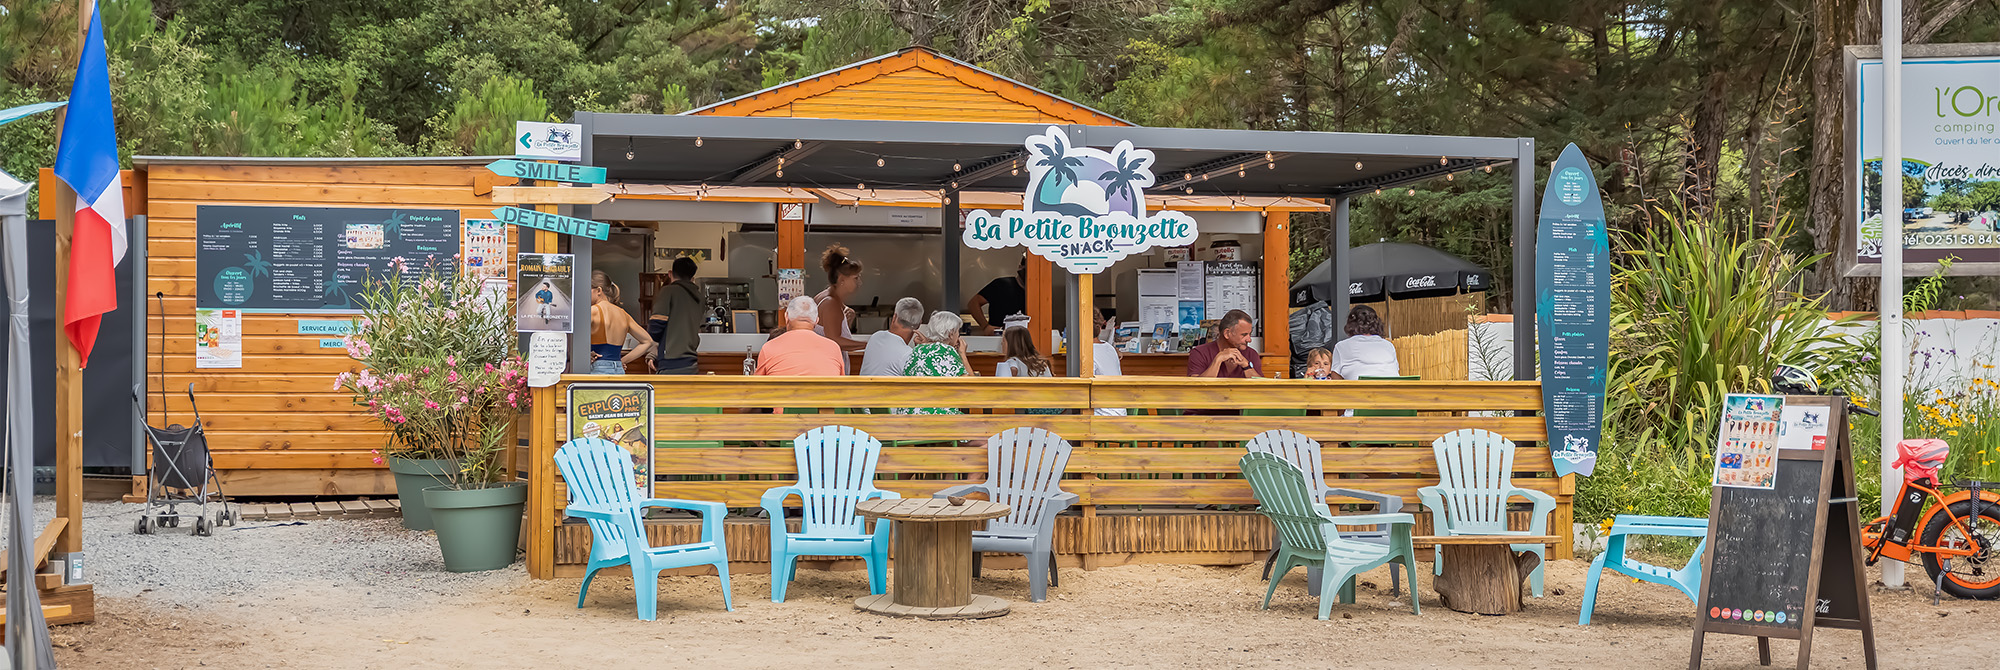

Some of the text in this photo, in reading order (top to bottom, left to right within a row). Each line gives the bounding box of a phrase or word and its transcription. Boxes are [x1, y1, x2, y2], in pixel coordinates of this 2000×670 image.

[1935, 85, 2000, 118] l'Or
[1934, 122, 1995, 134] camping
[1935, 137, 1964, 145] Ouvert
[1966, 137, 1978, 145] du
[514, 162, 580, 181] SMILE
[1927, 162, 1971, 180] Accès
[504, 207, 598, 238] DETENTE
[972, 216, 1190, 245] La Petite Bronzette
[1060, 238, 1114, 256] SNACK
[1904, 234, 1920, 244] tél.
[1924, 235, 1942, 245] 02
[1946, 235, 1957, 245] 51
[1960, 234, 1975, 244] 58
[1978, 234, 1992, 244] 84
[1406, 275, 1436, 289] Coca-Cola
[580, 394, 640, 416] EXPLORA
